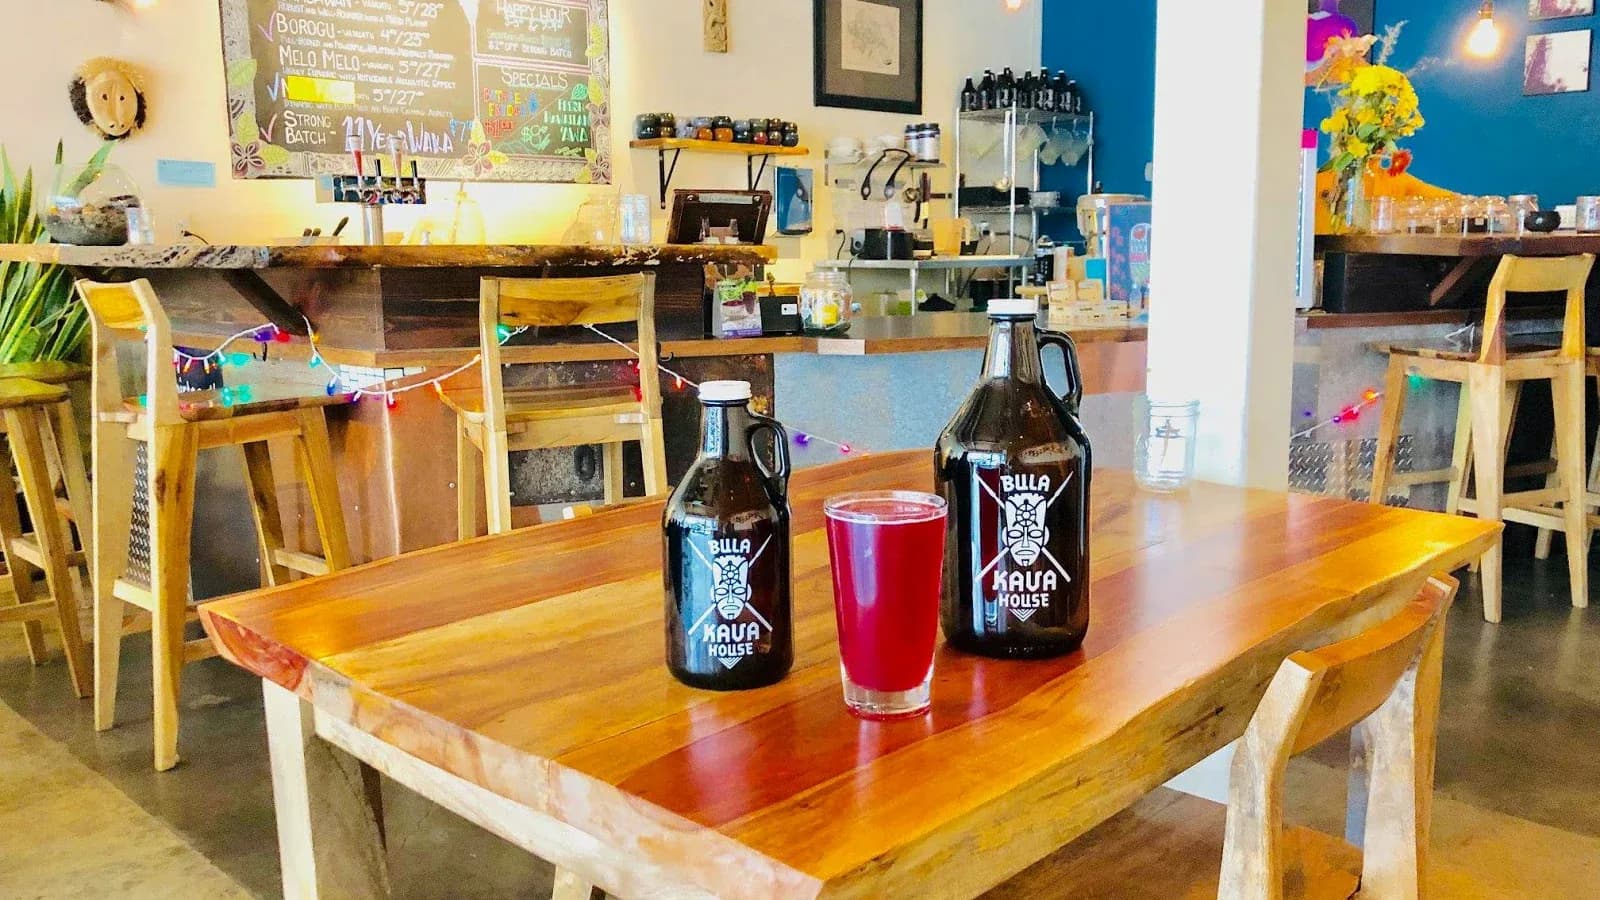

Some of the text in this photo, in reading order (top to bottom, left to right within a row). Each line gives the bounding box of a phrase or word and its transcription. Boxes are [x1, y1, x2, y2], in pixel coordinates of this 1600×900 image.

[276, 12, 336, 39] BOROGU
[279, 45, 317, 67] MELO
[322, 49, 360, 72] MELO
[501, 66, 568, 90] SPECIALS
[284, 110, 332, 129] STRONG
[285, 127, 327, 146] BATCH
[1000, 474, 1050, 492] BULA
[708, 538, 751, 554] BULA
[992, 569, 1057, 592] KAVA
[999, 593, 1050, 608] HOUSE
[703, 622, 760, 642] KAVA
[708, 643, 753, 657] HOUSE
